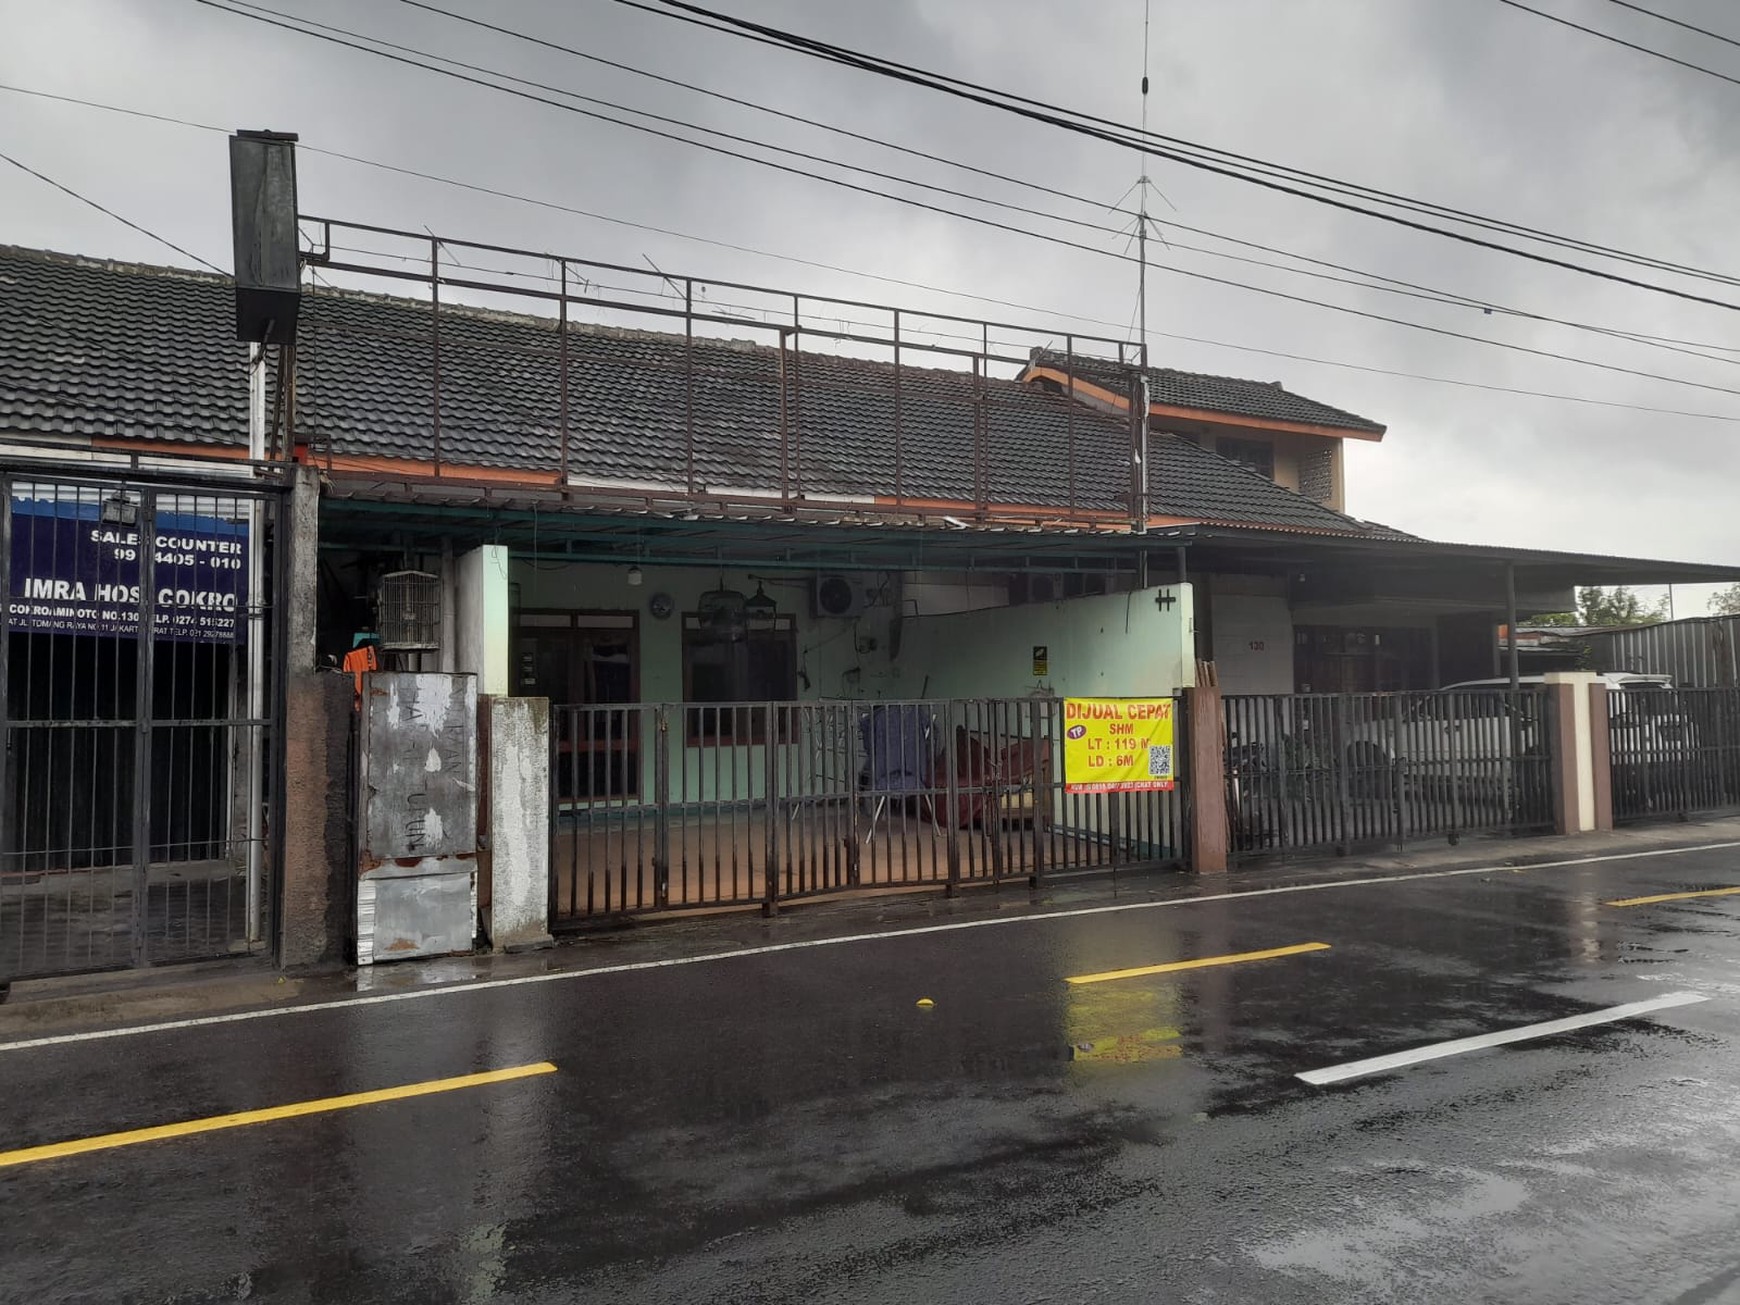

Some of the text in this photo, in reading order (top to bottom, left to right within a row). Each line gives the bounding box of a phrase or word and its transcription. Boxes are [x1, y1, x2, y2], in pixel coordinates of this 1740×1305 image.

[156, 537, 242, 555] COUNTER
[113, 548, 136, 562] 99
[154, 552, 195, 567] 4405
[210, 557, 241, 570] 010
[24, 578, 238, 613] IMRA HOS COKRO
[102, 610, 139, 622] NO.130
[110, 624, 139, 633] JKART
[1066, 703, 1171, 720] DIJUAL CEPAT
[1071, 726, 1083, 738] TP
[1109, 723, 1134, 735] SHM
[1087, 738, 1102, 750] LT
[1114, 738, 1136, 750] 119
[1088, 755, 1104, 767] LD
[1116, 755, 1134, 767] 6M
